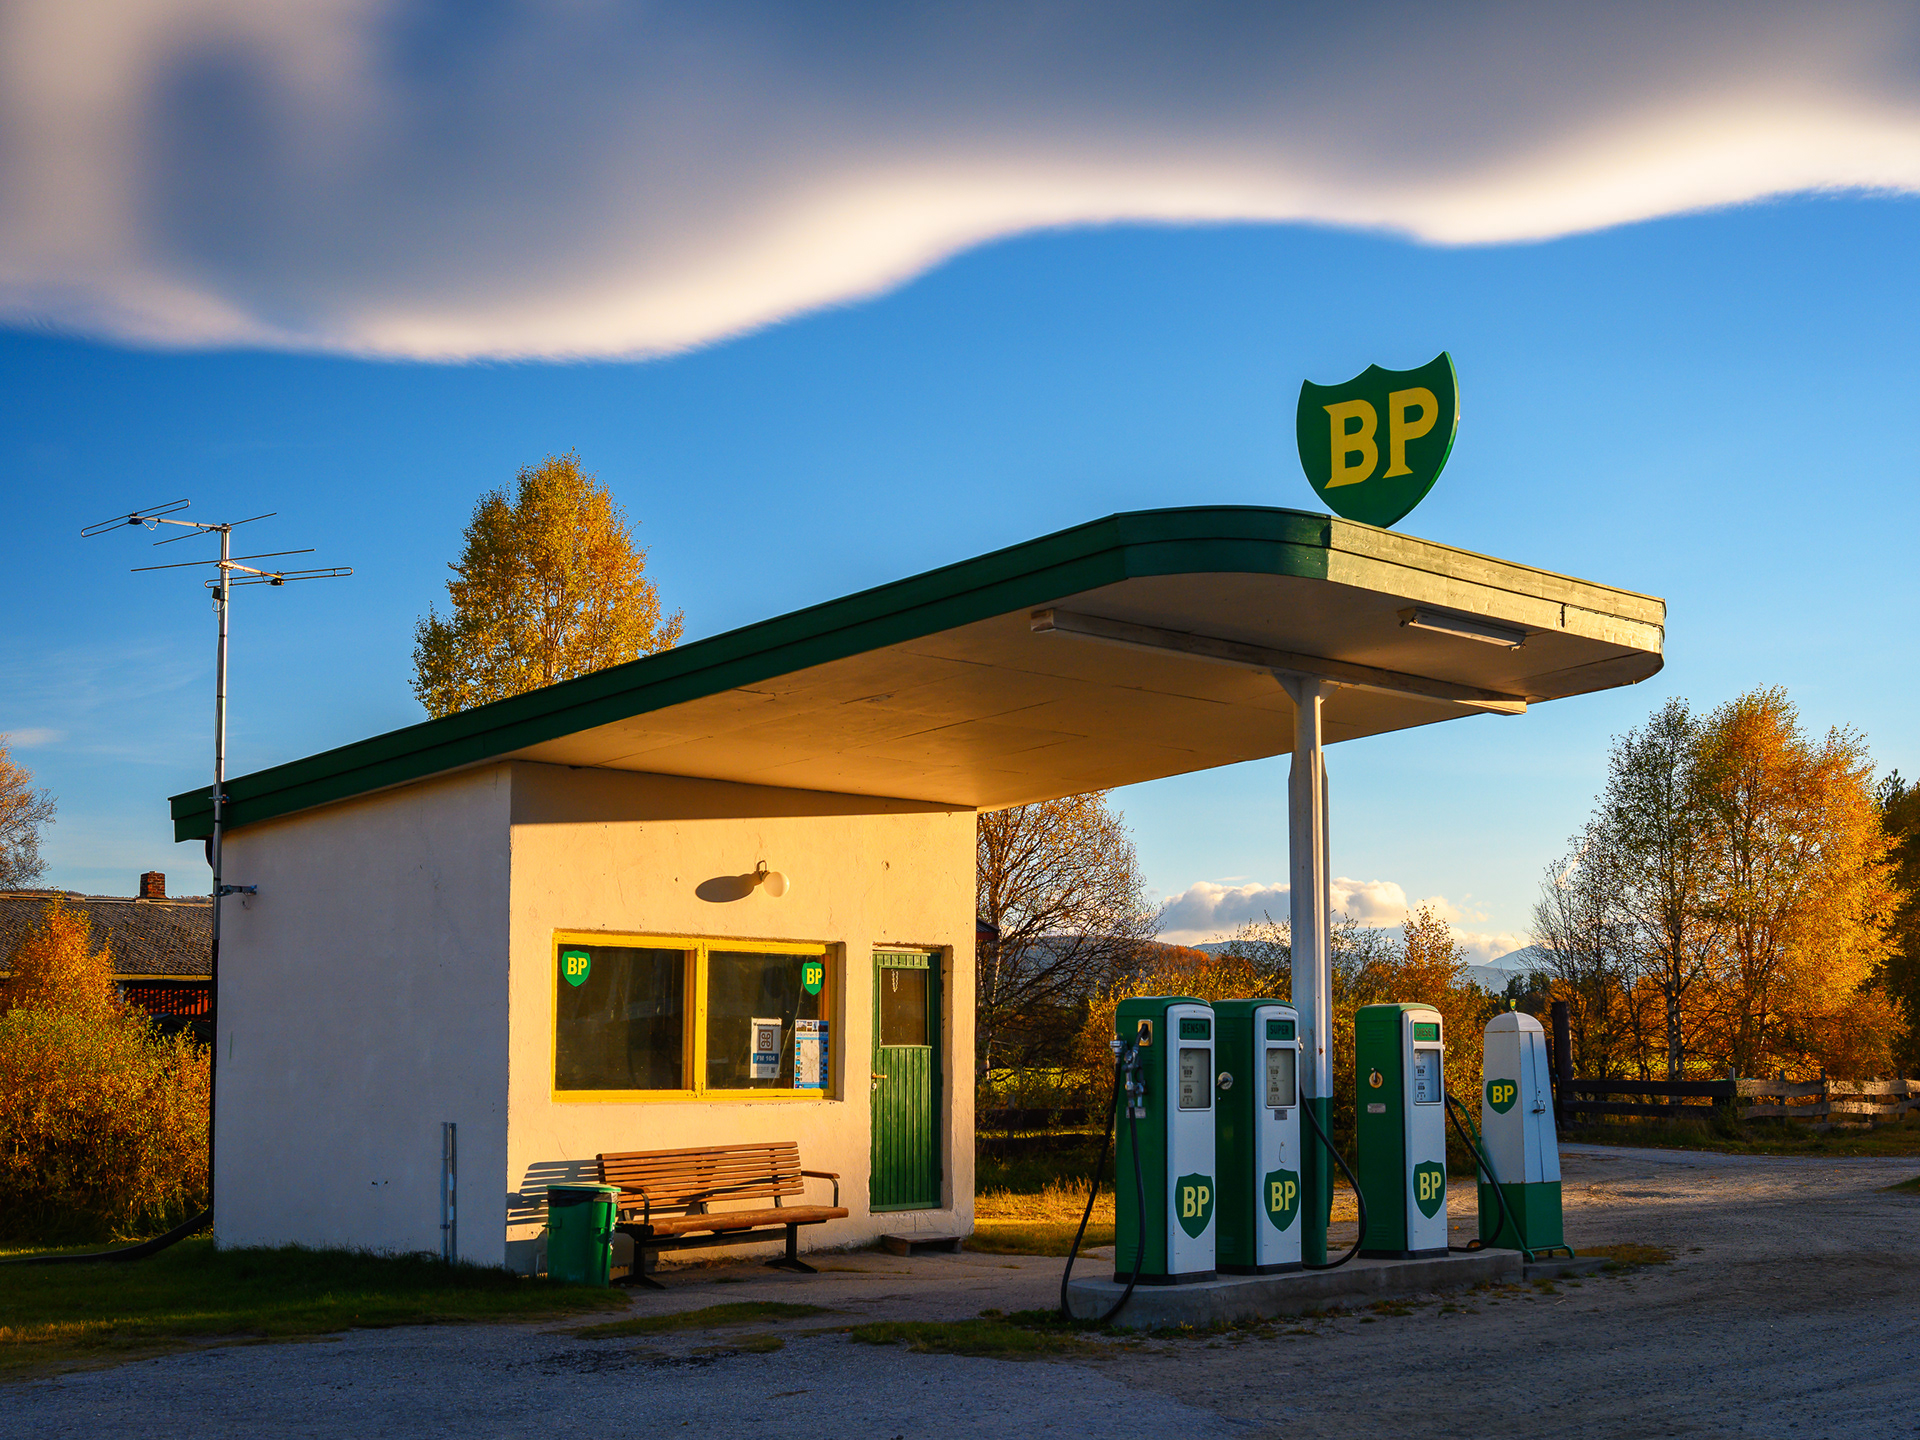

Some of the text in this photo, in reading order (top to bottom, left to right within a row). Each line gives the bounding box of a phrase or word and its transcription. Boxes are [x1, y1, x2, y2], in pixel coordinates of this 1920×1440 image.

[1322, 387, 1439, 489] BP
[566, 957, 588, 976] BP
[806, 968, 823, 985] BP
[1182, 1023, 1206, 1034] BENSIN
[1270, 1024, 1290, 1035] SUPER
[1416, 1027, 1435, 1038] DIESEL
[1492, 1085, 1514, 1103] BP
[1419, 1171, 1442, 1200] BP
[1182, 1186, 1210, 1218] BP
[1270, 1181, 1296, 1212] BP
